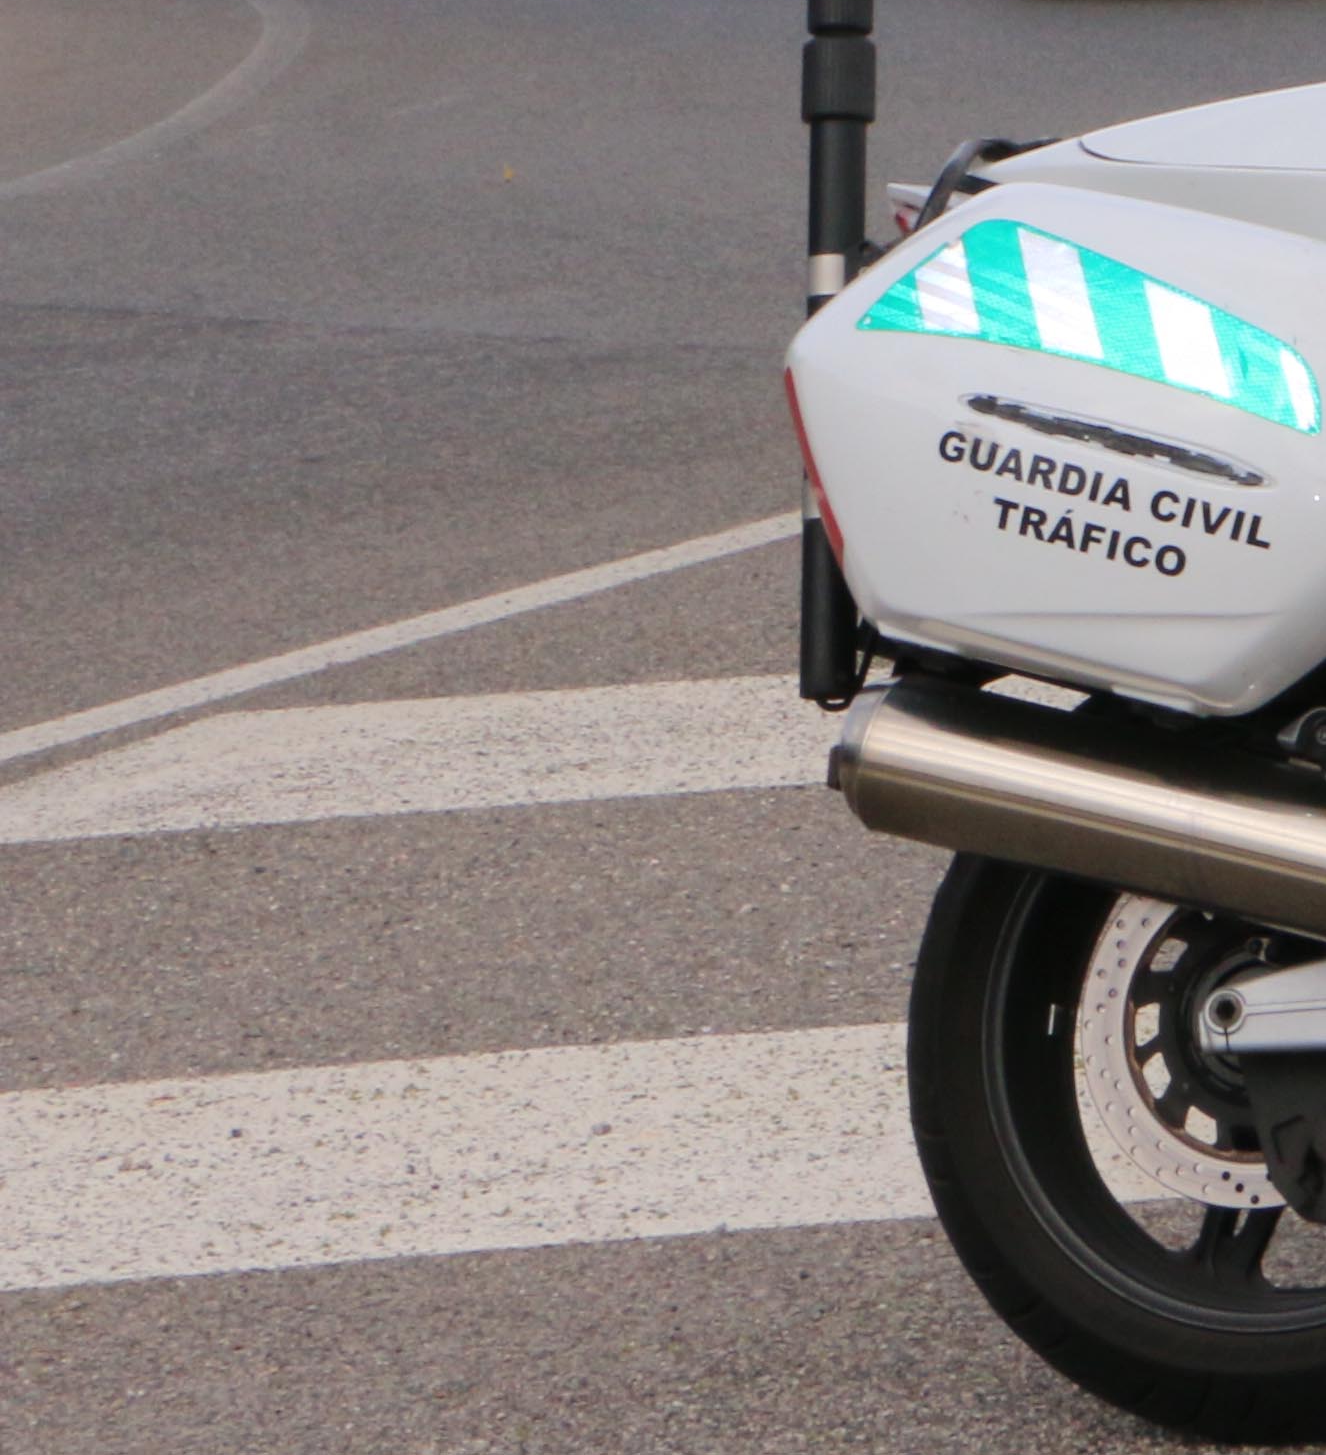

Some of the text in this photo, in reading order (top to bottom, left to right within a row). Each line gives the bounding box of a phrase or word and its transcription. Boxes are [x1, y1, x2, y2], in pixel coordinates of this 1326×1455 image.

[938, 430, 1272, 550] GUARDIA CIVIL
[993, 497, 1187, 577] TRÁFICO
